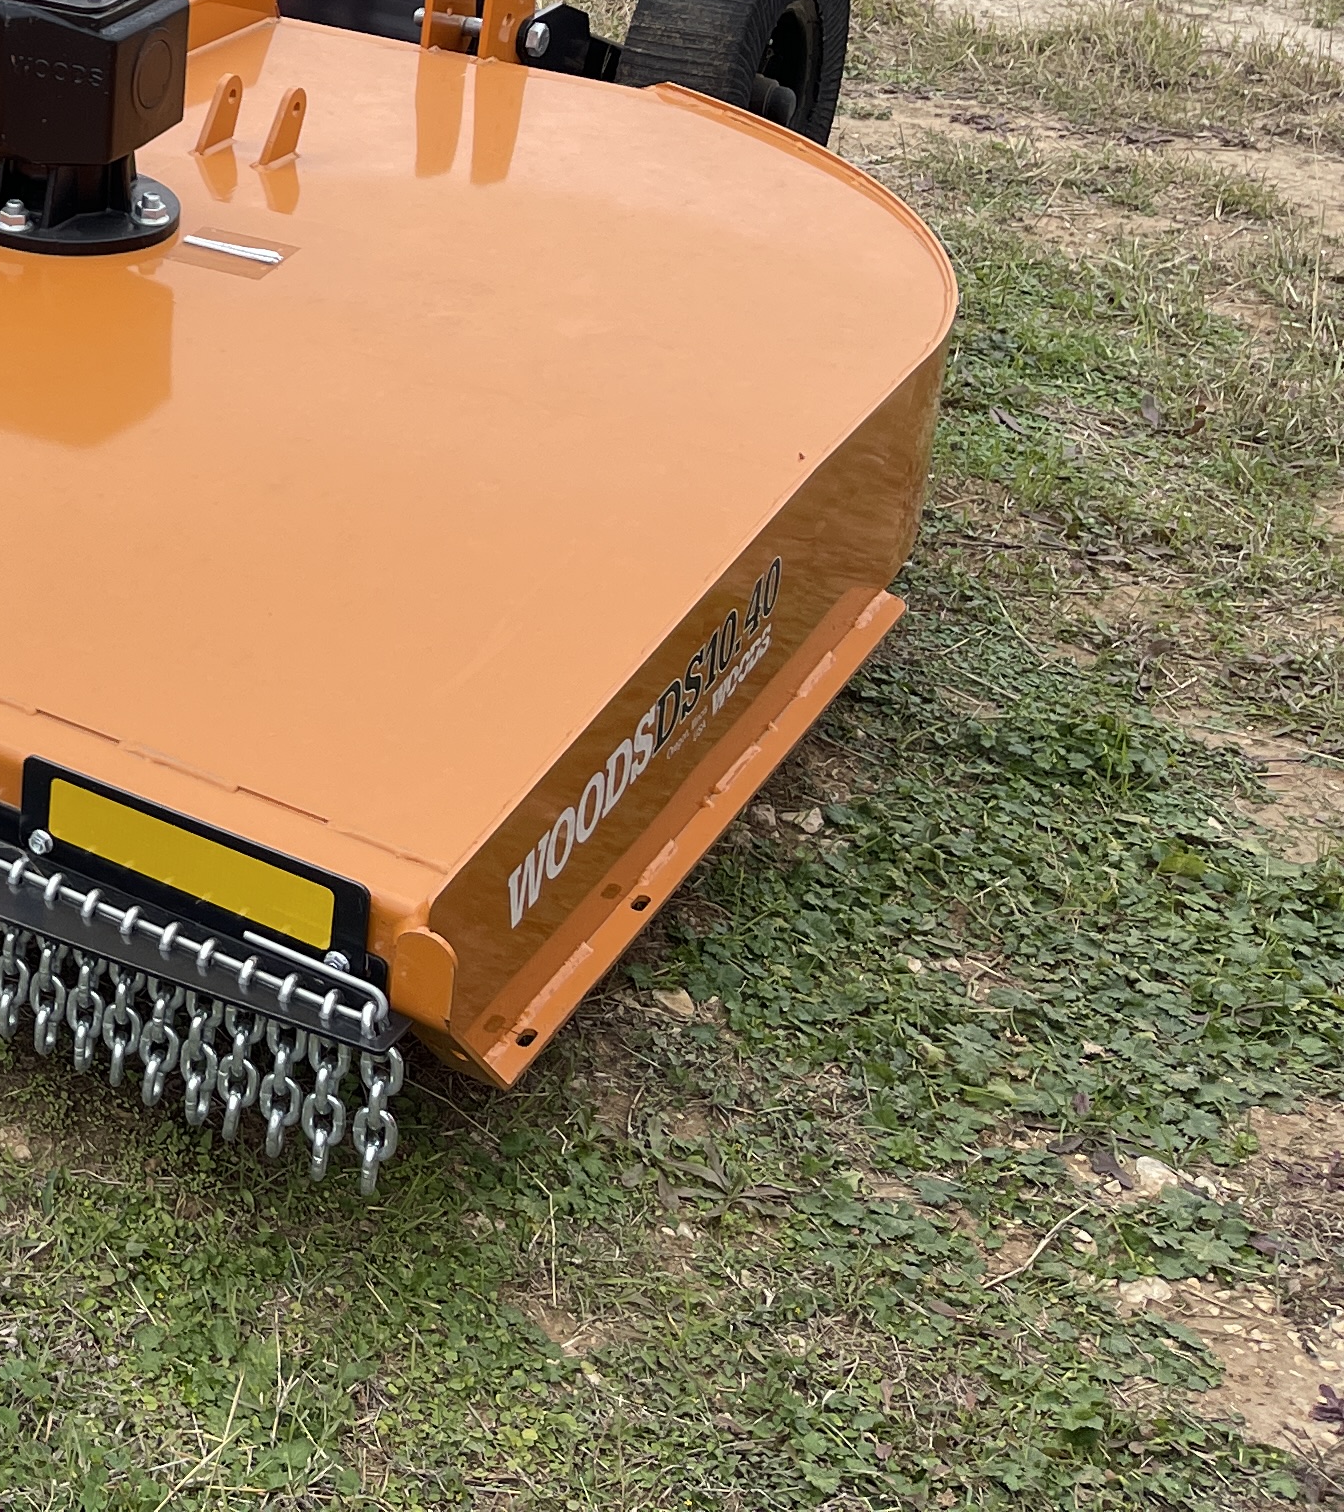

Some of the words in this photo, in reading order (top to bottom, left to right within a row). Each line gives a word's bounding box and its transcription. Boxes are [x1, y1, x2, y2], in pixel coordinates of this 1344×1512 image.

[9, 53, 105, 87] WOODS
[711, 623, 772, 718] WOODS
[507, 704, 657, 930] WOODS
[650, 556, 783, 758] DS10.40
